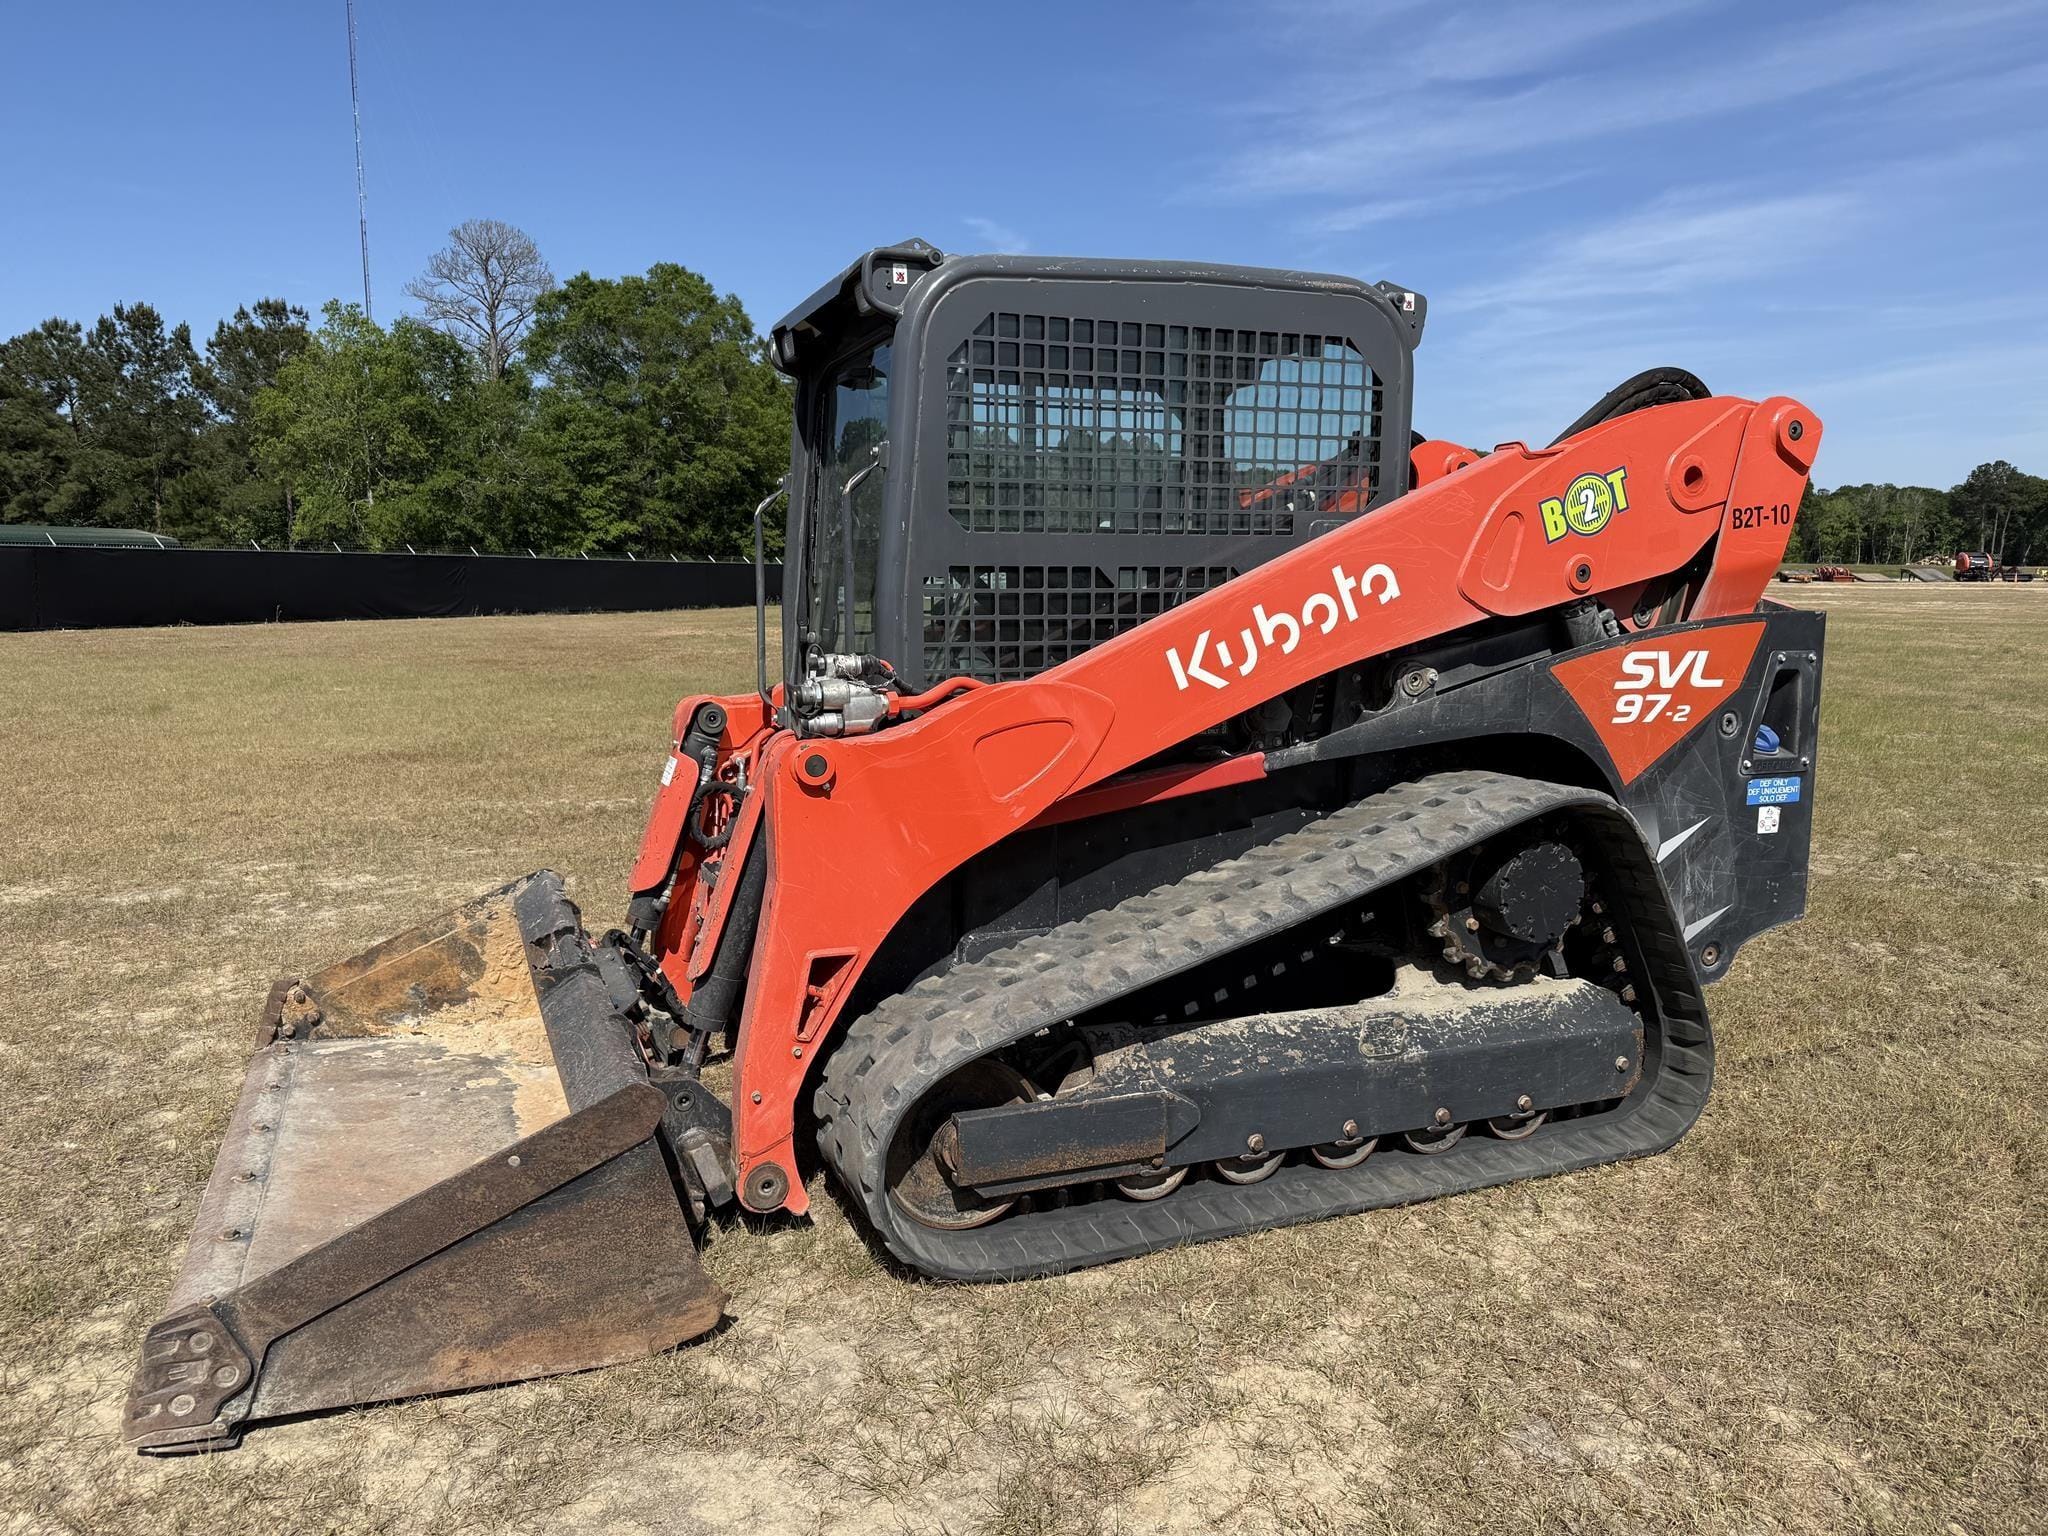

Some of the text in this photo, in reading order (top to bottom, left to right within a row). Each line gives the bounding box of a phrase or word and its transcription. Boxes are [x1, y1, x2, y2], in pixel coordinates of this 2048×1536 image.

[1732, 503, 1790, 529] B2T-10
[1165, 563, 1401, 691] Kubota
[1613, 650, 1724, 690] SVL
[1611, 694, 1691, 724] 97-2
[1748, 785, 1799, 796] DEF UNIQUEMENT
[1760, 779, 1789, 788] DEF ONLY
[1759, 793, 1788, 803] SOLO DEF
